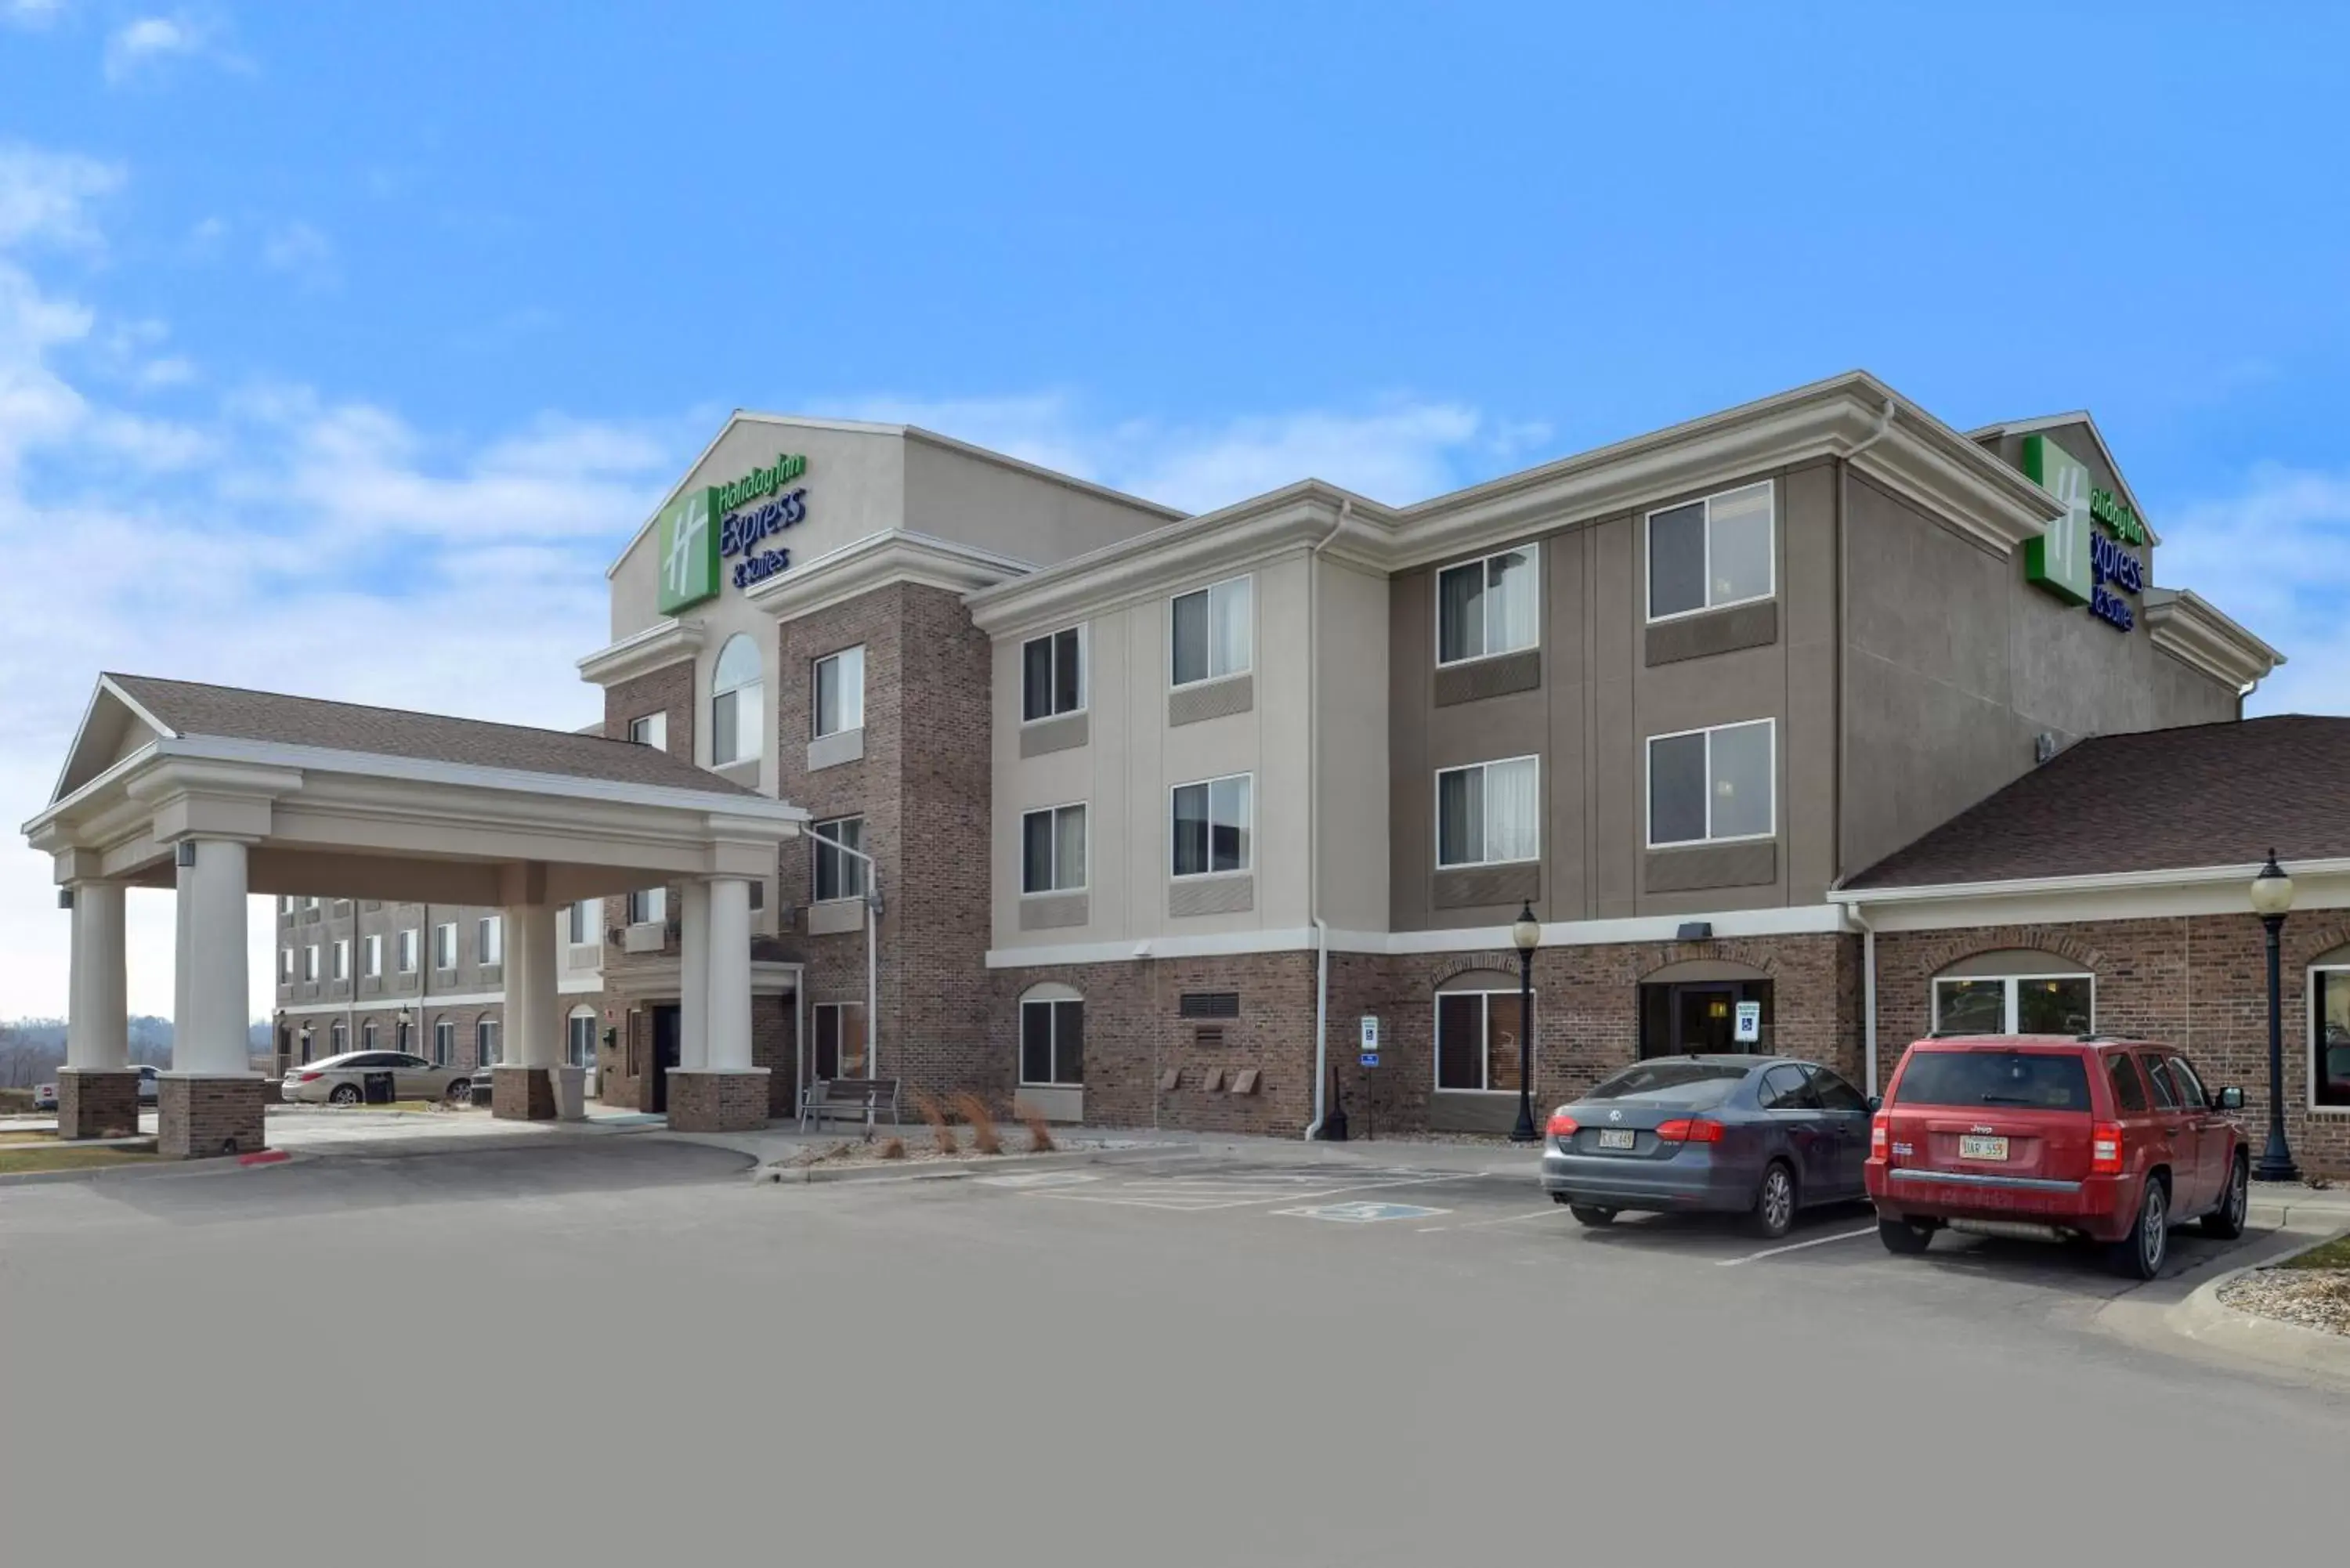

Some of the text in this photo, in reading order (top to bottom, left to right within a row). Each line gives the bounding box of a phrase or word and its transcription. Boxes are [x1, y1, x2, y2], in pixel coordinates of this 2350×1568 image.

[718, 453, 805, 514] Holiday Inn
[720, 487, 806, 557] Express
[2091, 487, 2144, 546] oliday Inn
[733, 548, 790, 588] & Suites
[1970, 1122, 1992, 1135] Jeep
